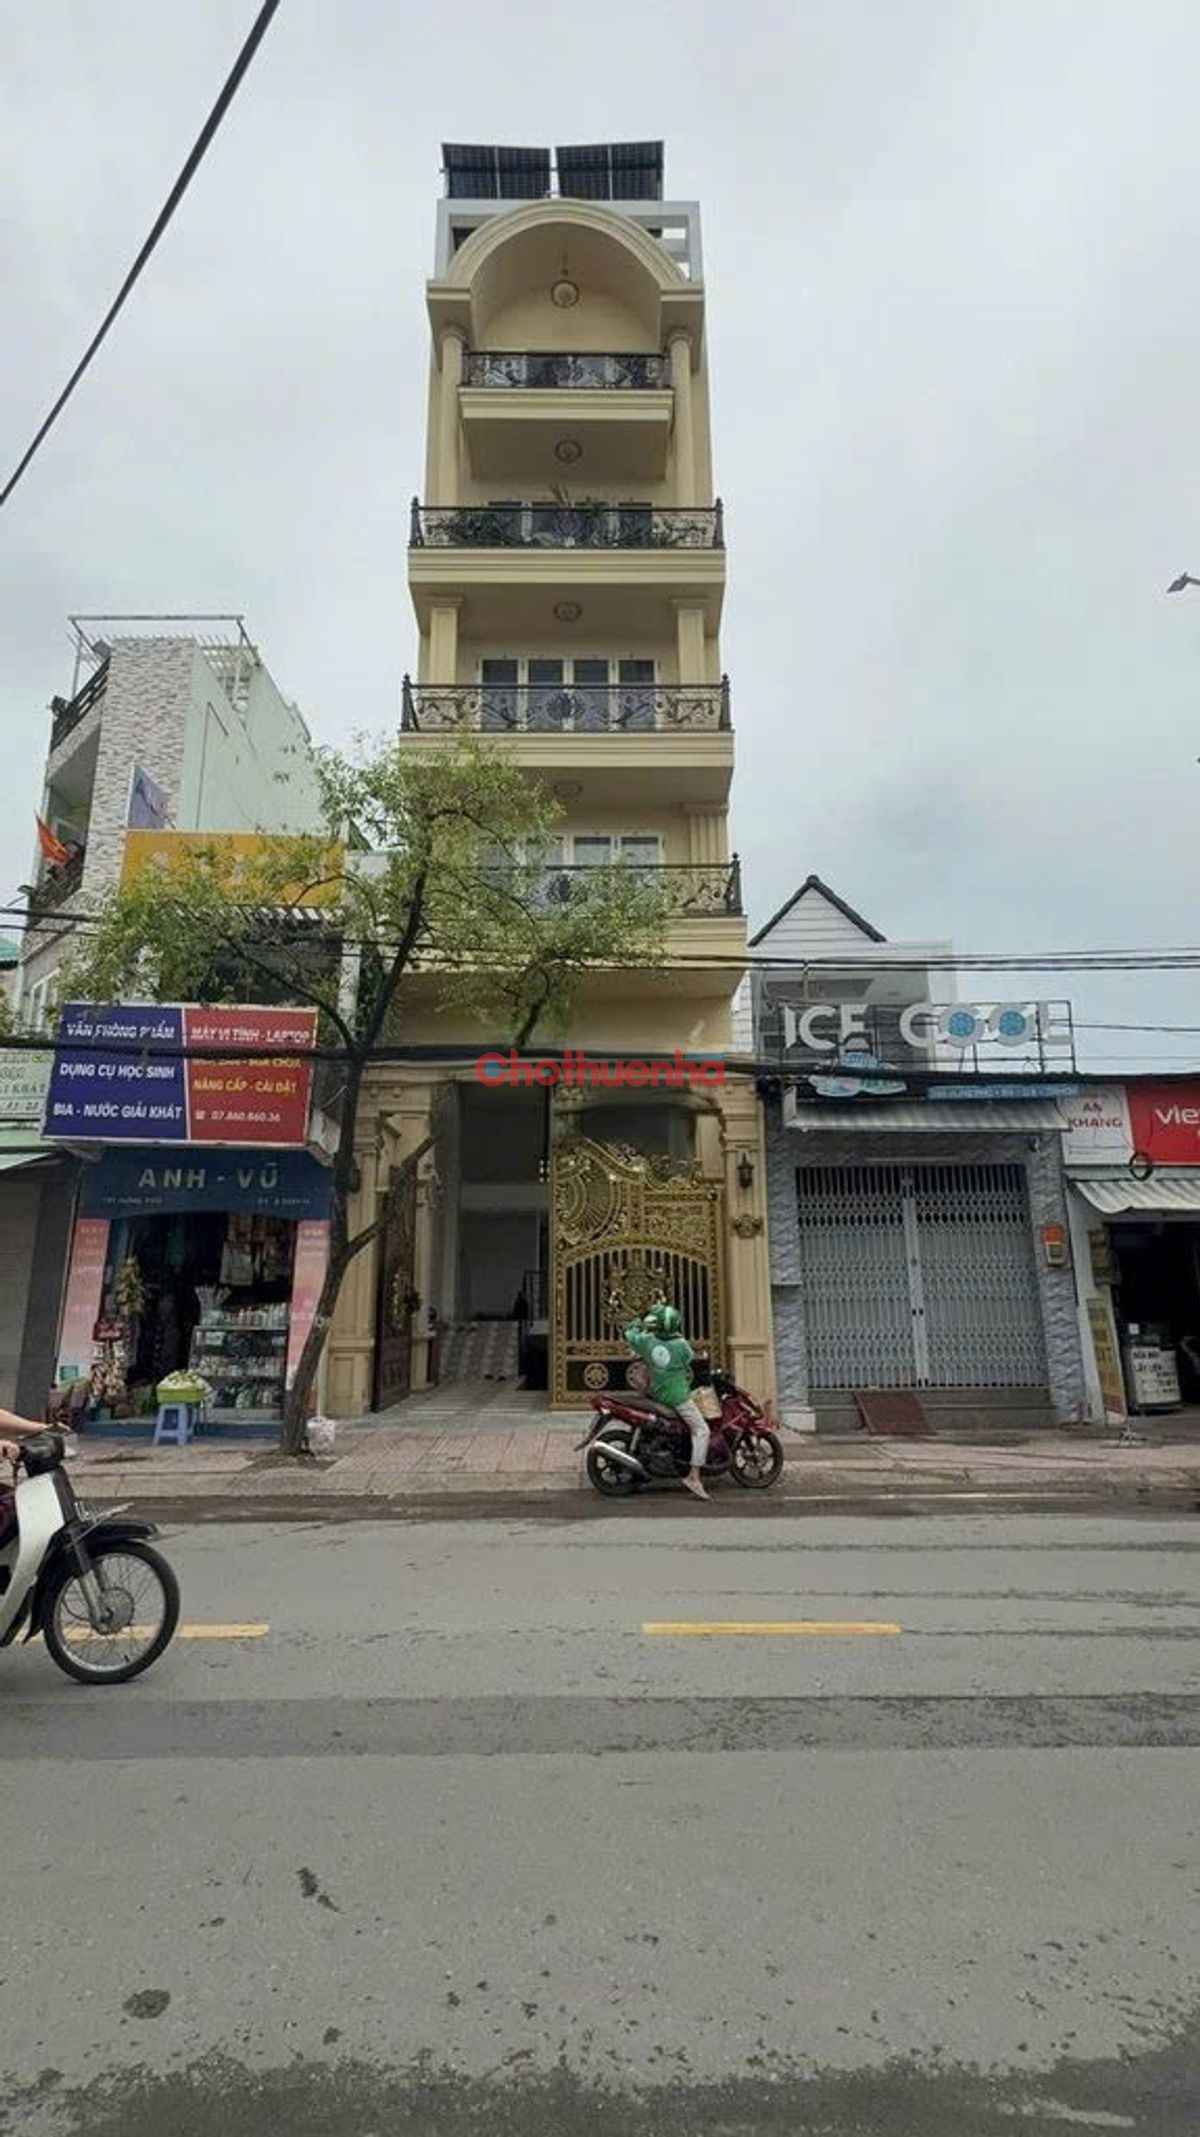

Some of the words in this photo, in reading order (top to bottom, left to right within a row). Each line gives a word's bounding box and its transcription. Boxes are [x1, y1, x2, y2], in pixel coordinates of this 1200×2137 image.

[784, 1003, 870, 1050] ICE
[900, 1001, 1072, 1048] COOL
[59, 1062, 95, 1080] DỤNG
[97, 1063, 116, 1080] CỤ
[117, 1065, 144, 1082] HỌC
[145, 1066, 175, 1078] SINH
[53, 1103, 73, 1116] BIA
[148, 1104, 183, 1120] KHÁT
[1083, 1102, 1102, 1112] AN
[1155, 1104, 1200, 1124] vie
[1068, 1117, 1122, 1128] KHANG
[138, 1168, 205, 1188] ANH
[237, 1163, 278, 1188] VŨ
